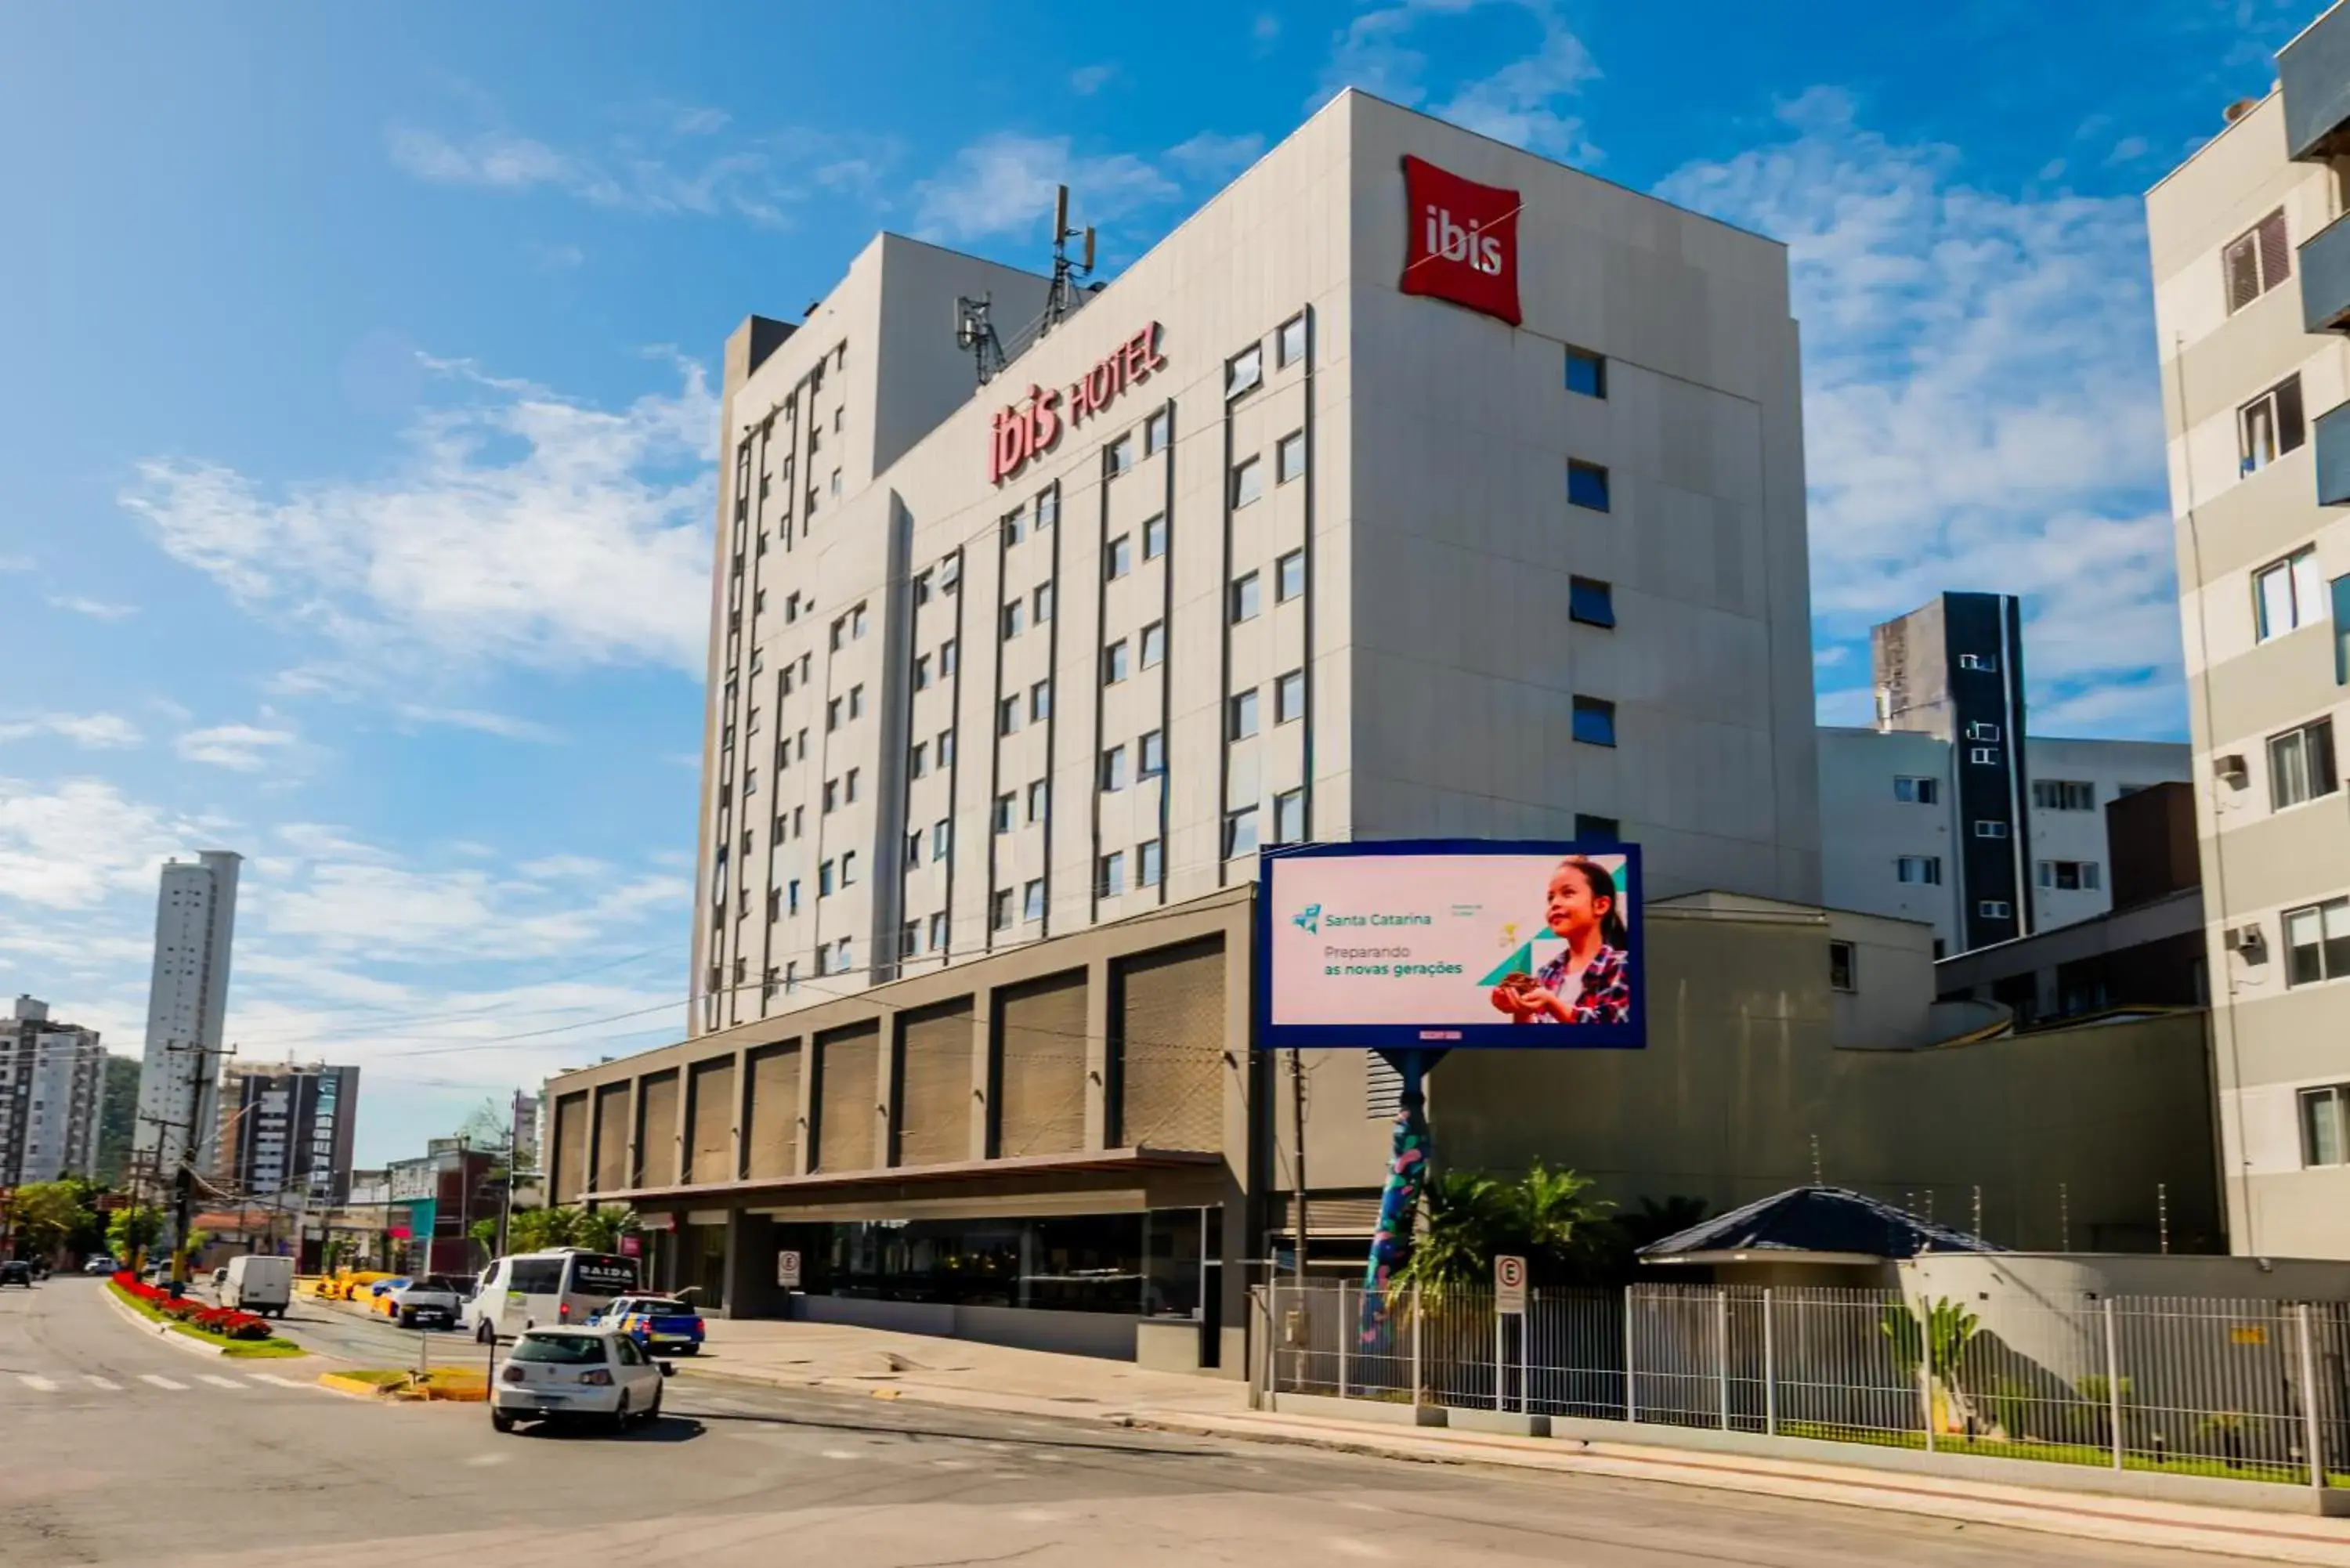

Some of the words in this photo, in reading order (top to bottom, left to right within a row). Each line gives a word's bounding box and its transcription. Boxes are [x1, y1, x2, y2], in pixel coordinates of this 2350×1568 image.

[1426, 204, 1502, 276] ibis
[987, 383, 1059, 485] ibis
[1068, 321, 1164, 427] HOTEL
[1325, 914, 1366, 927] Santa
[1371, 912, 1431, 926] Catarina
[1324, 945, 1410, 959] Preparando
[1324, 964, 1340, 975] as
[1345, 963, 1389, 975] novas
[1394, 961, 1462, 977] gerações
[1506, 1263, 1516, 1281] E
